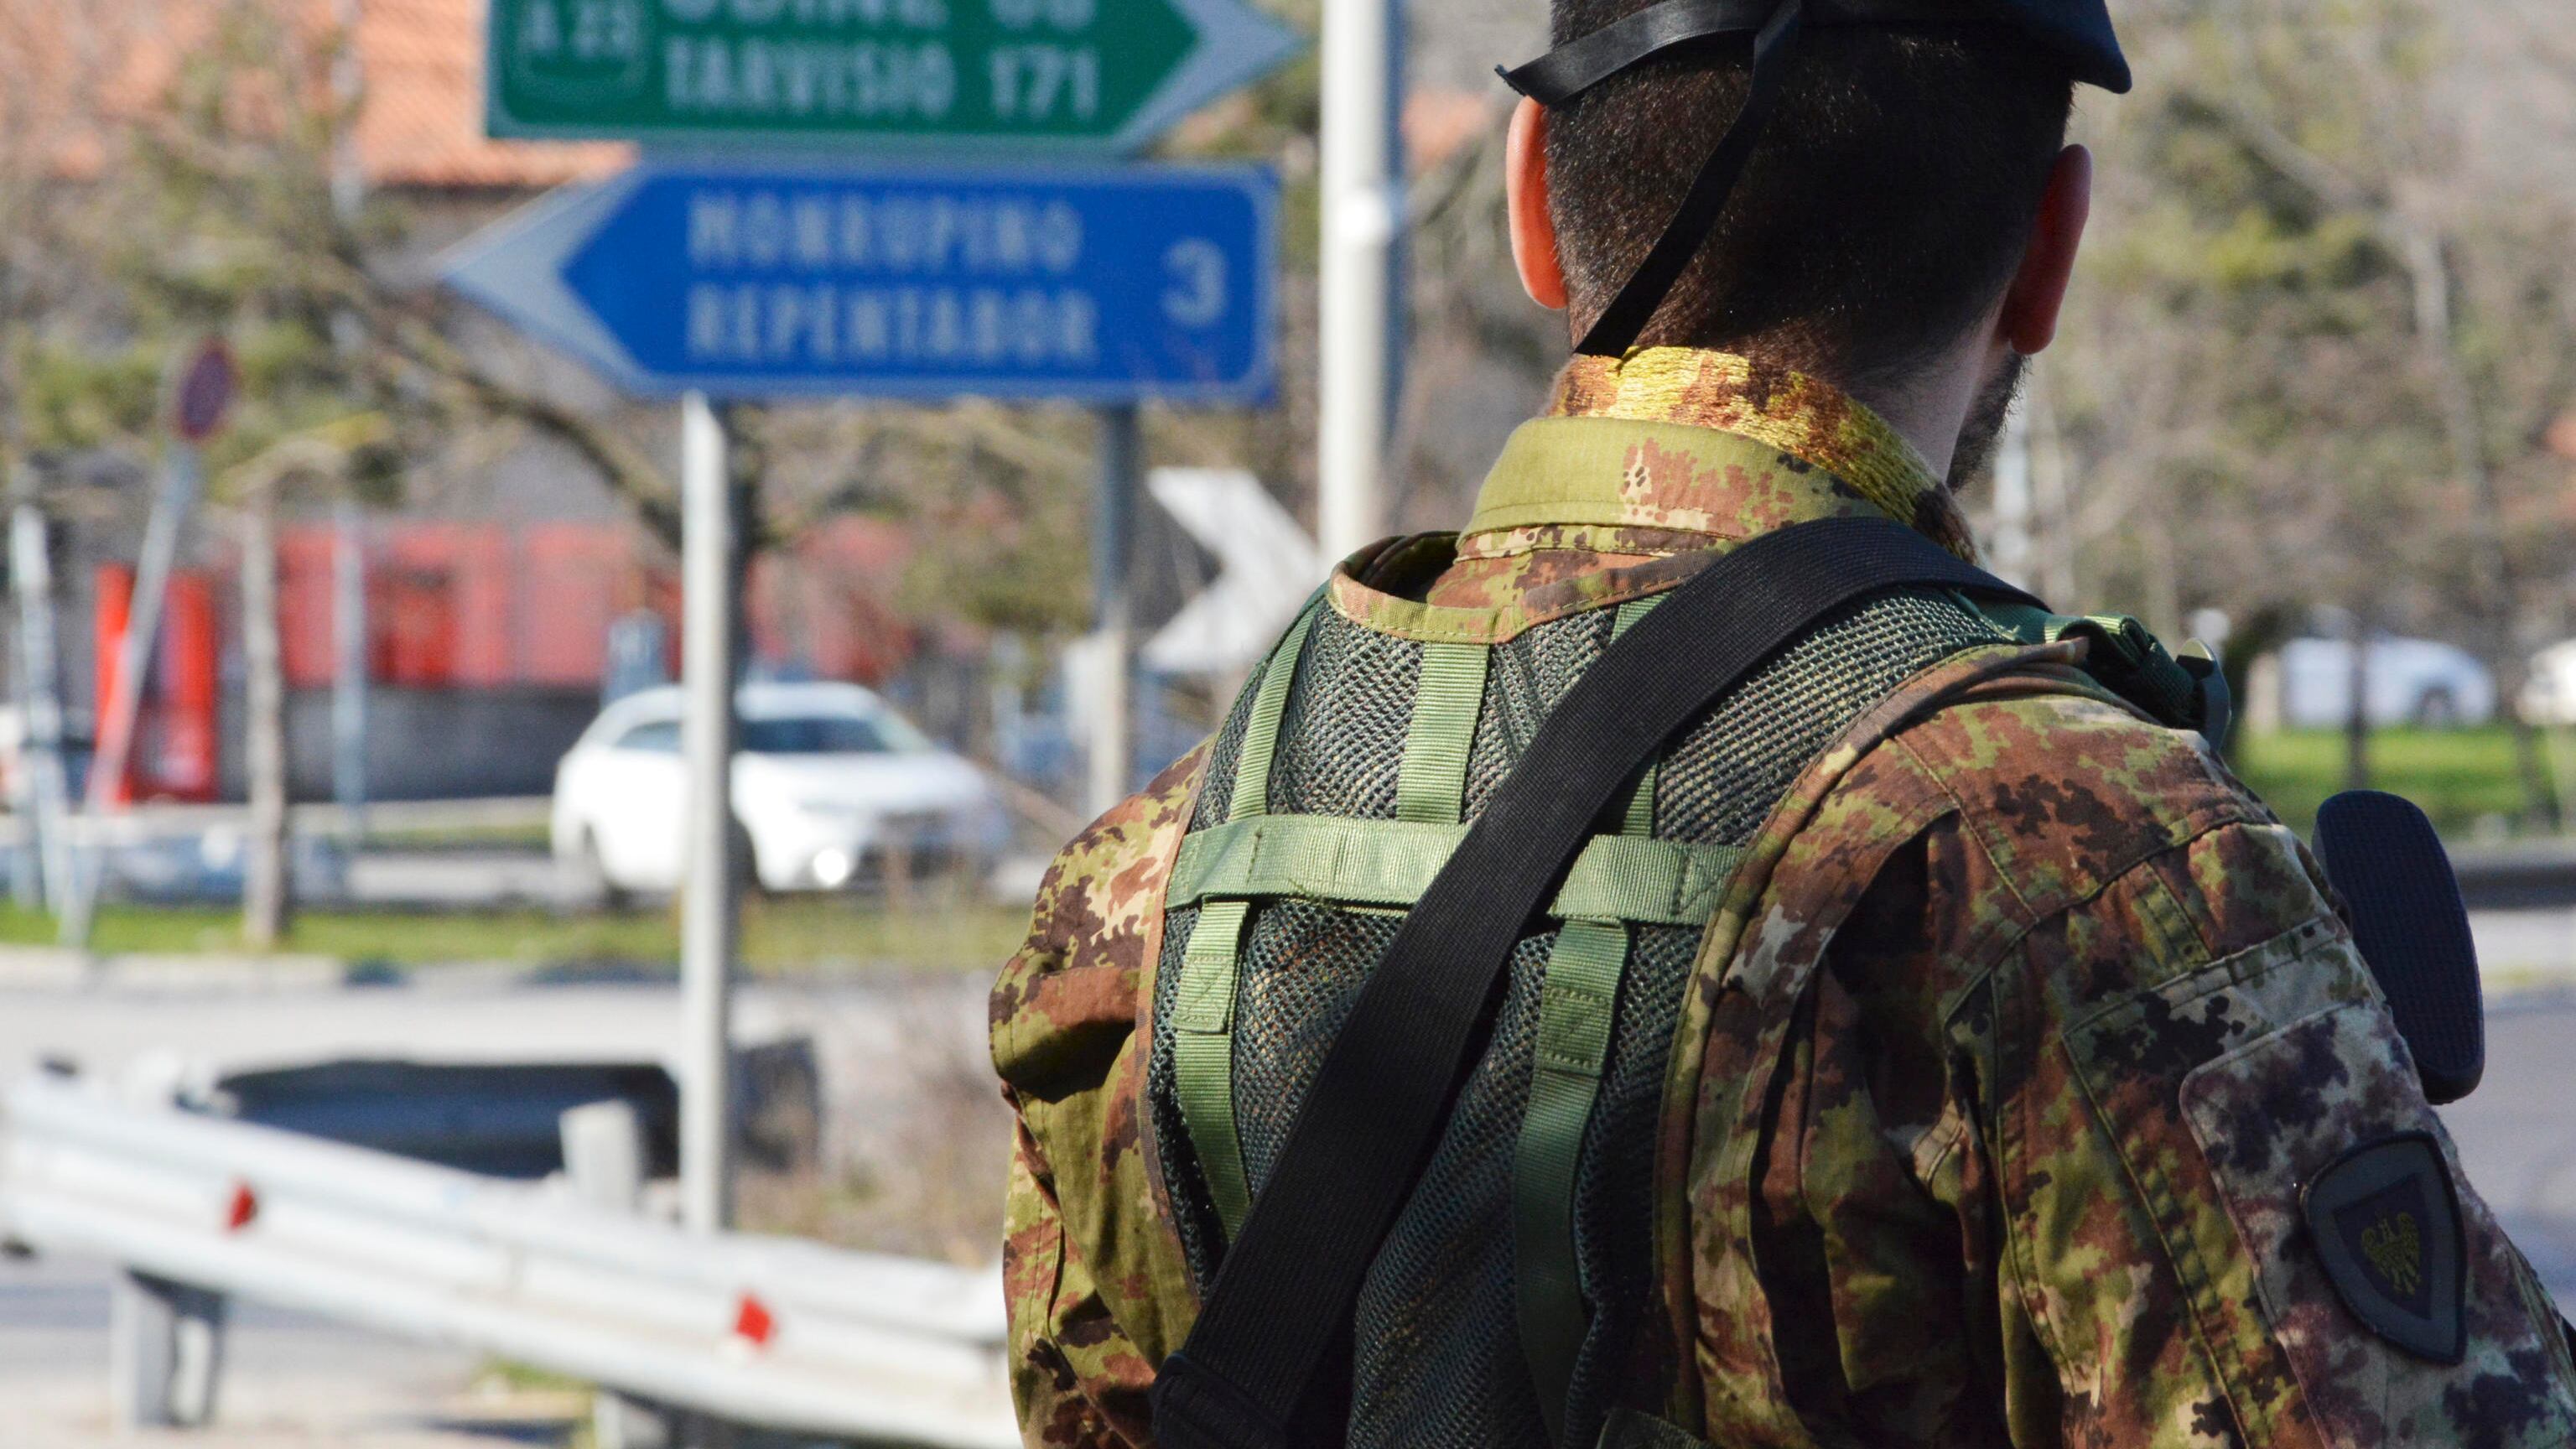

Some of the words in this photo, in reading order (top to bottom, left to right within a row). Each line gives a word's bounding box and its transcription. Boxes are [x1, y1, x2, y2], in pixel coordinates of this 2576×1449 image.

[667, 35, 954, 118] TARVISIO
[989, 44, 1099, 120] 171
[688, 193, 1083, 272] MONRUPINO
[1164, 238, 1226, 325] 3
